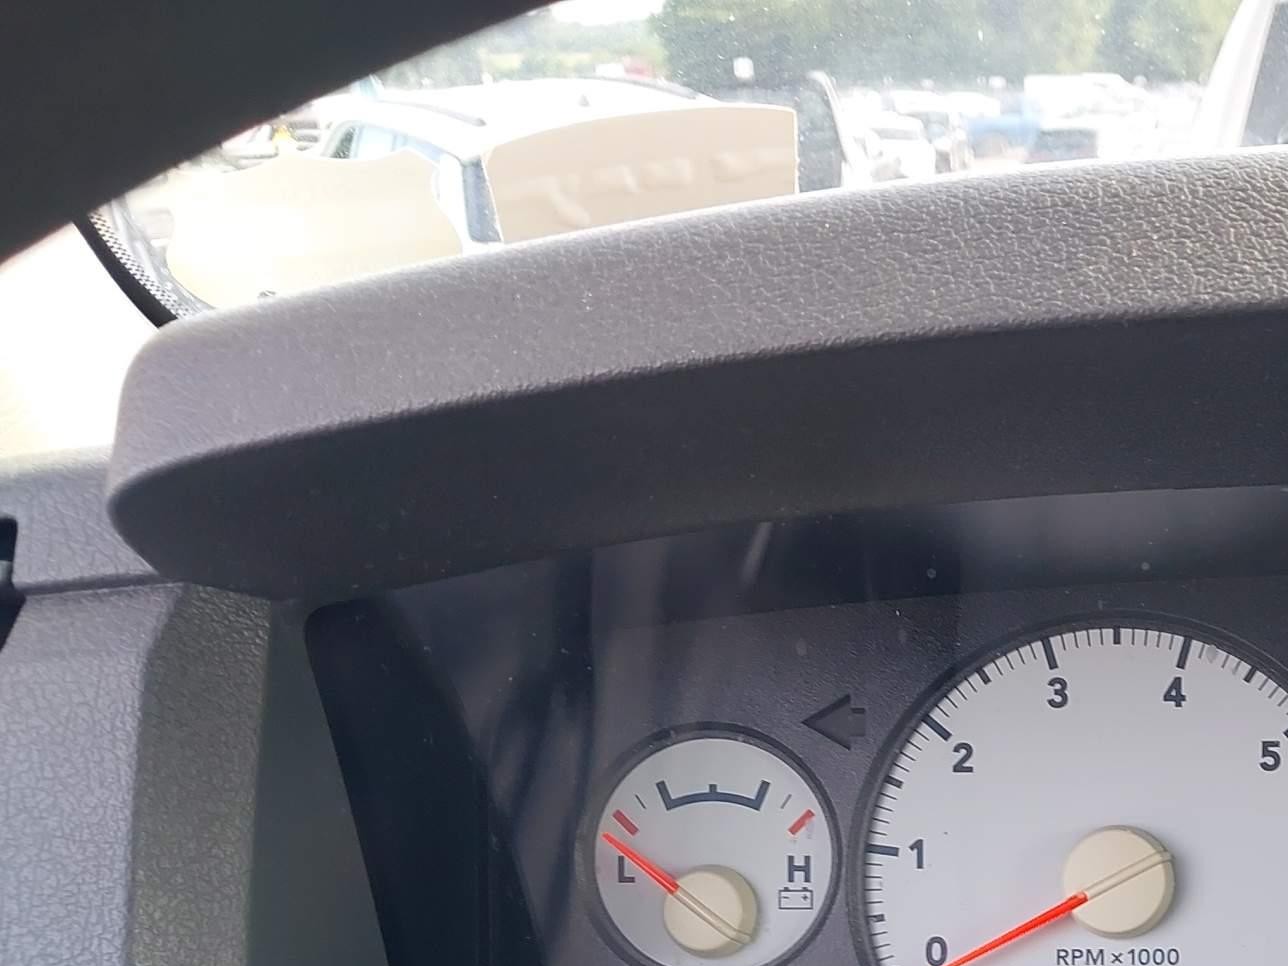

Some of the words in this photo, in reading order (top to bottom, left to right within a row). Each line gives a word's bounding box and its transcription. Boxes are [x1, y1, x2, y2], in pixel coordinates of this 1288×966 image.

[1046, 676, 1069, 709] 3
[1162, 676, 1187, 708] 4
[952, 742, 974, 773] 2
[1259, 740, 1281, 772] 5
[617, 854, 636, 884] L
[787, 855, 812, 884] H
[908, 838, 924, 870] 1
[1056, 948, 1105, 966] RPM
